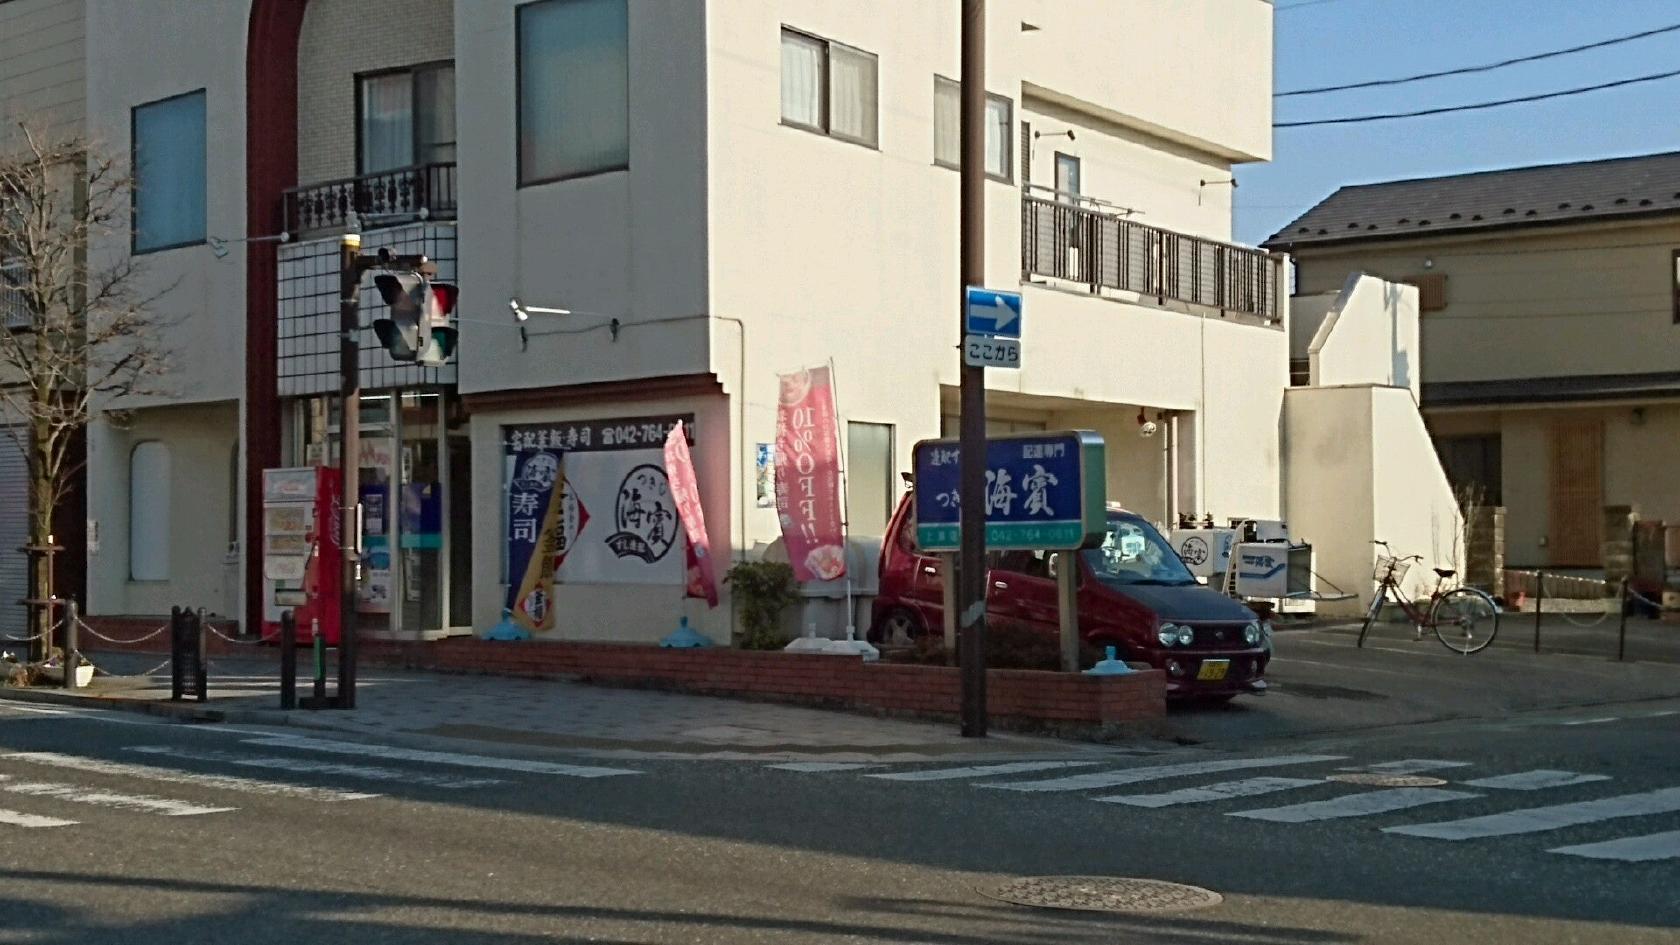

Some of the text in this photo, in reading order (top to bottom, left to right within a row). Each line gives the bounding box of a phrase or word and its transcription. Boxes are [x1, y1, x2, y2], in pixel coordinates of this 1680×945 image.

[970, 343, 1018, 361] ここから
[512, 492, 539, 543] 寿司
